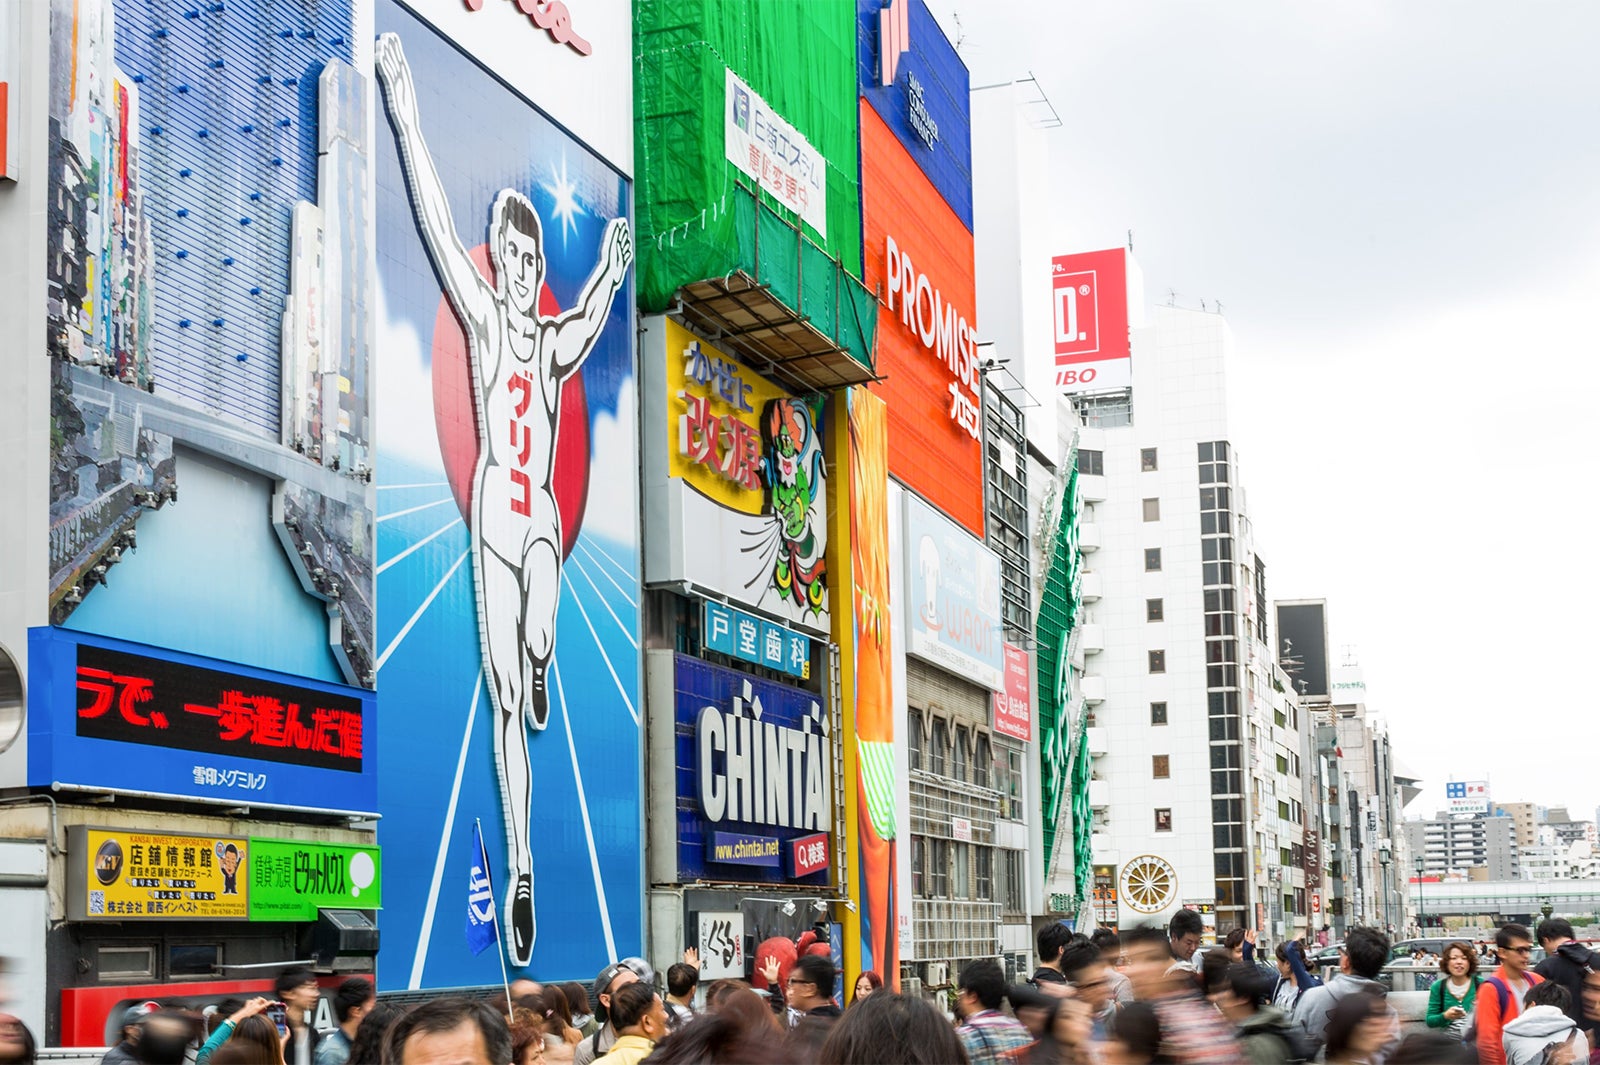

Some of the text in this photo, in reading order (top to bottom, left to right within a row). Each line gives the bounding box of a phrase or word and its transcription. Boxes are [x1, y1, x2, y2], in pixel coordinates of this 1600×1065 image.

[887, 234, 980, 399] PROMISE
[684, 340, 754, 413] かぜに
[507, 370, 535, 519] グリコ
[677, 390, 762, 491] 改源
[712, 609, 806, 671] 戸堂歯科
[193, 765, 267, 790] 雪印メグミルク
[698, 690, 832, 832] CHINTAI
[129, 836, 213, 848] KANSAI INVEST CORPORATION
[130, 845, 213, 868] 店舗情報館
[808, 841, 826, 866] 検索
[294, 850, 346, 895] ピタットハウス
[107, 901, 199, 914] 株式会社 関西インベスト
